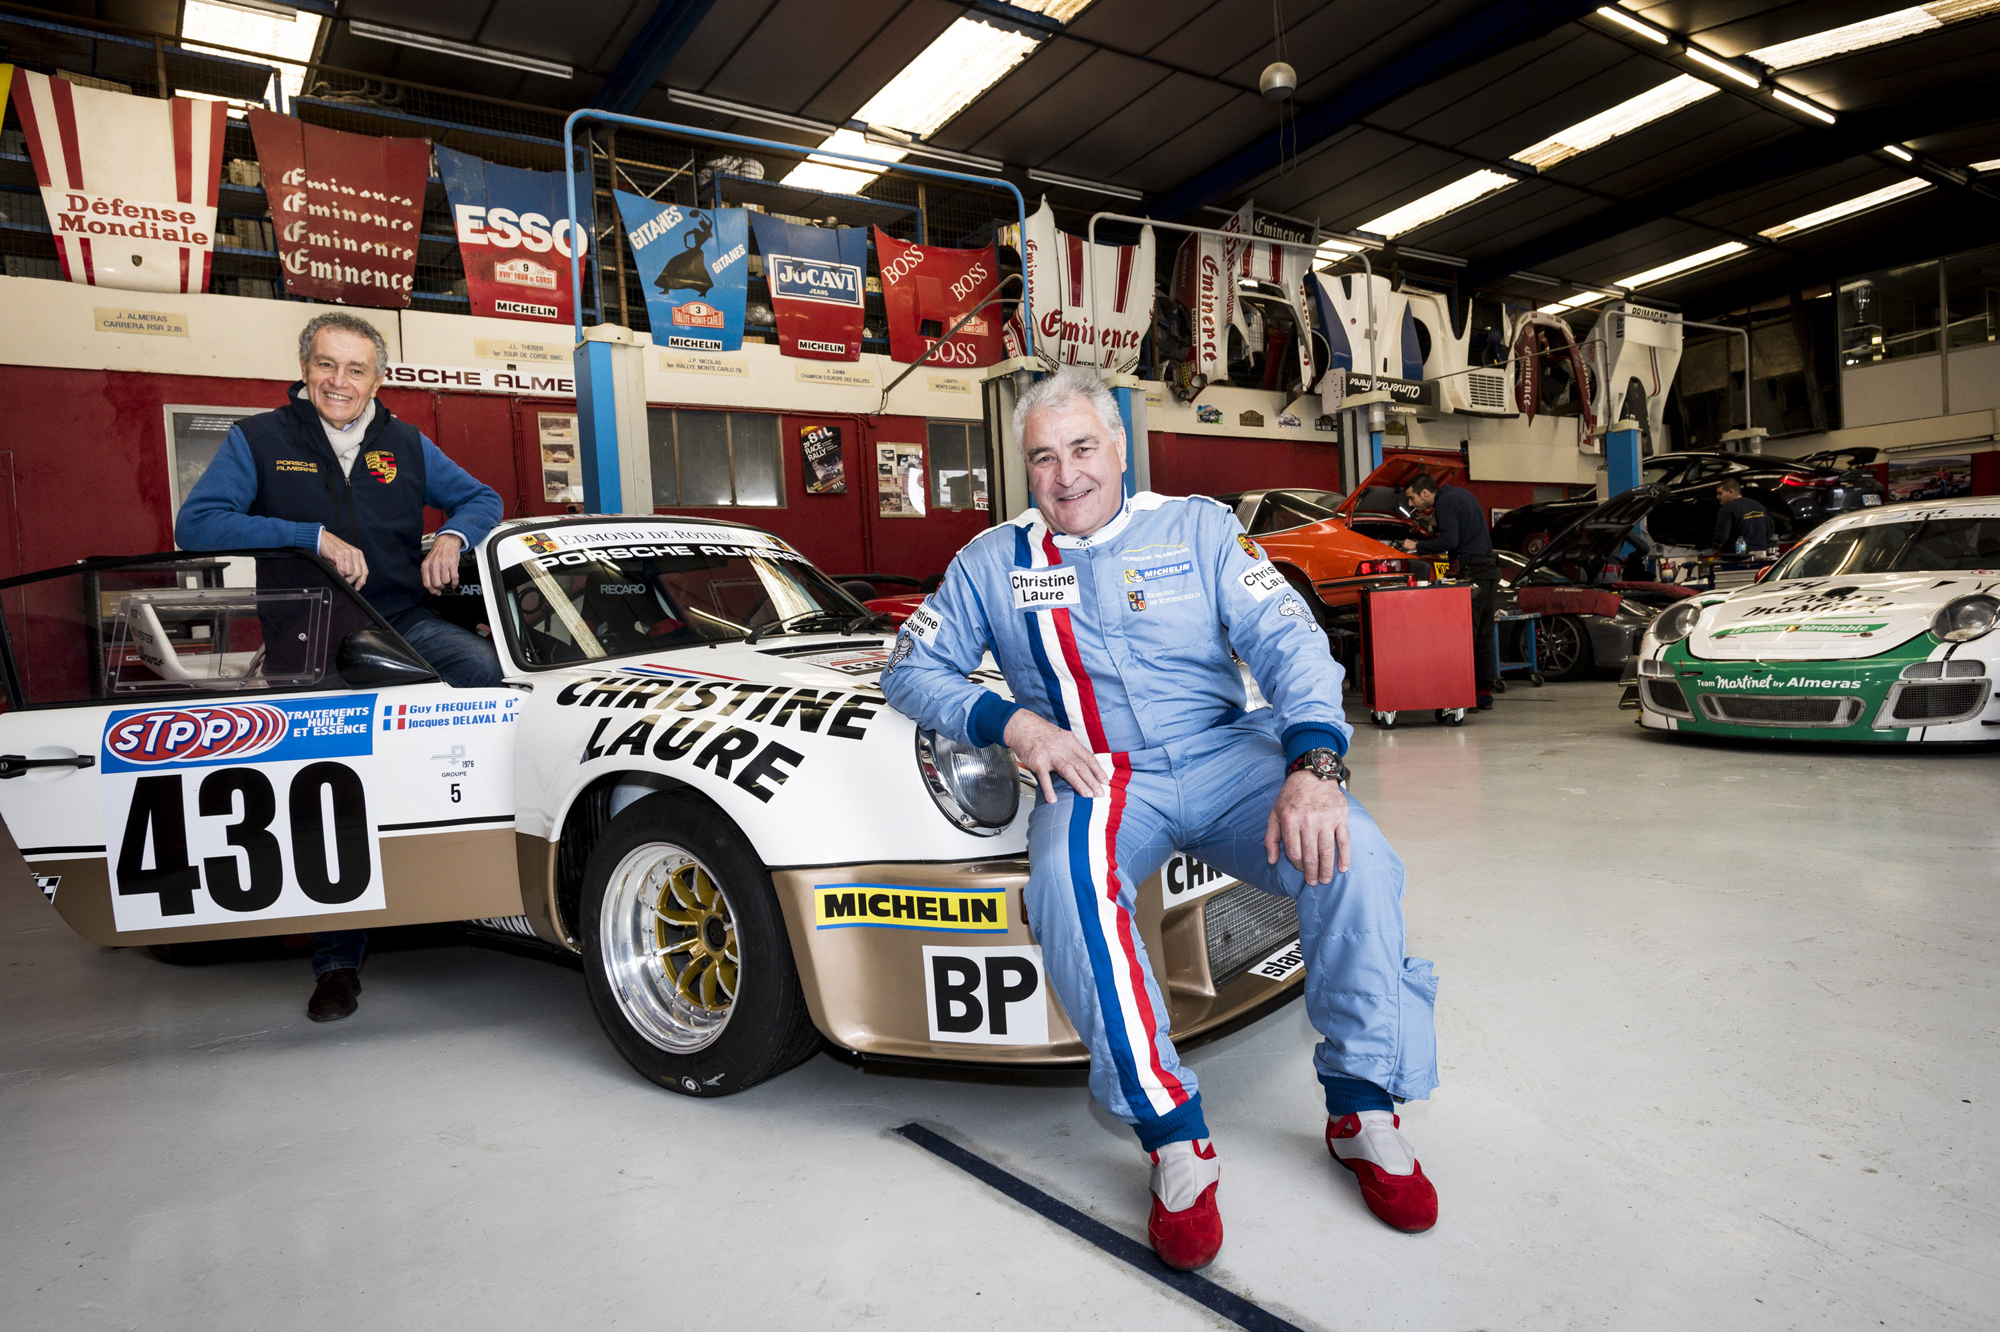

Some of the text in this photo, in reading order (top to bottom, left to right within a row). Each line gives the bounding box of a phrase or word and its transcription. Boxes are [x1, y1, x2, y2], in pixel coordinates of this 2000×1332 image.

[66, 194, 196, 224] Défense
[283, 192, 413, 231] Eminence
[58, 213, 208, 245] Mondiale
[455, 204, 588, 258] ESSO
[629, 205, 683, 250] GITANES
[1254, 216, 1306, 243] Eminence
[284, 220, 414, 260] Eminence
[712, 244, 746, 274] GITANES
[881, 244, 925, 285] BOSS
[285, 248, 413, 291] Eminence
[523, 263, 529, 272] 9
[536, 275, 553, 284] CORSE
[779, 265, 855, 291] JOCAVI
[950, 262, 988, 302] BOSS
[809, 288, 828, 296] JEANS
[496, 301, 556, 316] MICHELIN
[695, 306, 701, 314] 3
[1202, 255, 1219, 362] Eminence
[127, 313, 167, 322] ALMERAS
[103, 320, 145, 330] CARRERA
[147, 323, 164, 331] RSR
[670, 338, 721, 349] MICHELIN
[799, 341, 844, 353] MICHELIN
[1003, 334, 1017, 358] ESS
[529, 352, 548, 360] CORSE
[925, 339, 976, 365] BOSS
[494, 373, 574, 393] ALME
[804, 442, 823, 455] RACE
[807, 448, 827, 461] RALLY
[276, 460, 317, 468] PORSCHE
[276, 465, 318, 473] ALMERAS
[558, 530, 771, 546] EDMOND DE ROTHSCHILD
[534, 545, 695, 572] PORSCHE
[1154, 547, 1190, 559] ALMERAS
[1144, 563, 1190, 577] MICHELIN
[1244, 565, 1277, 586] Chris
[600, 583, 646, 595] RECARO
[1011, 574, 1075, 590] Christine
[1261, 576, 1285, 590] Lau
[1022, 589, 1064, 603] Laure
[1146, 590, 1175, 599] EDMOND
[1697, 674, 1862, 689] Team Martinet by Almeras
[287, 706, 369, 720] TRAITEMENTS
[409, 704, 432, 714] Guy
[557, 676, 888, 740] CHRISTINE
[307, 717, 345, 727] HUILE
[408, 718, 450, 729] Jacques
[452, 714, 497, 726] DELAVAL
[293, 724, 367, 737] ET ESSENCE
[461, 760, 475, 768] 1976
[580, 714, 805, 803] LAURE
[450, 783, 461, 803] 5
[117, 761, 372, 917] 430
[824, 893, 997, 923] MICHELIN
[932, 955, 1038, 1035] BP
